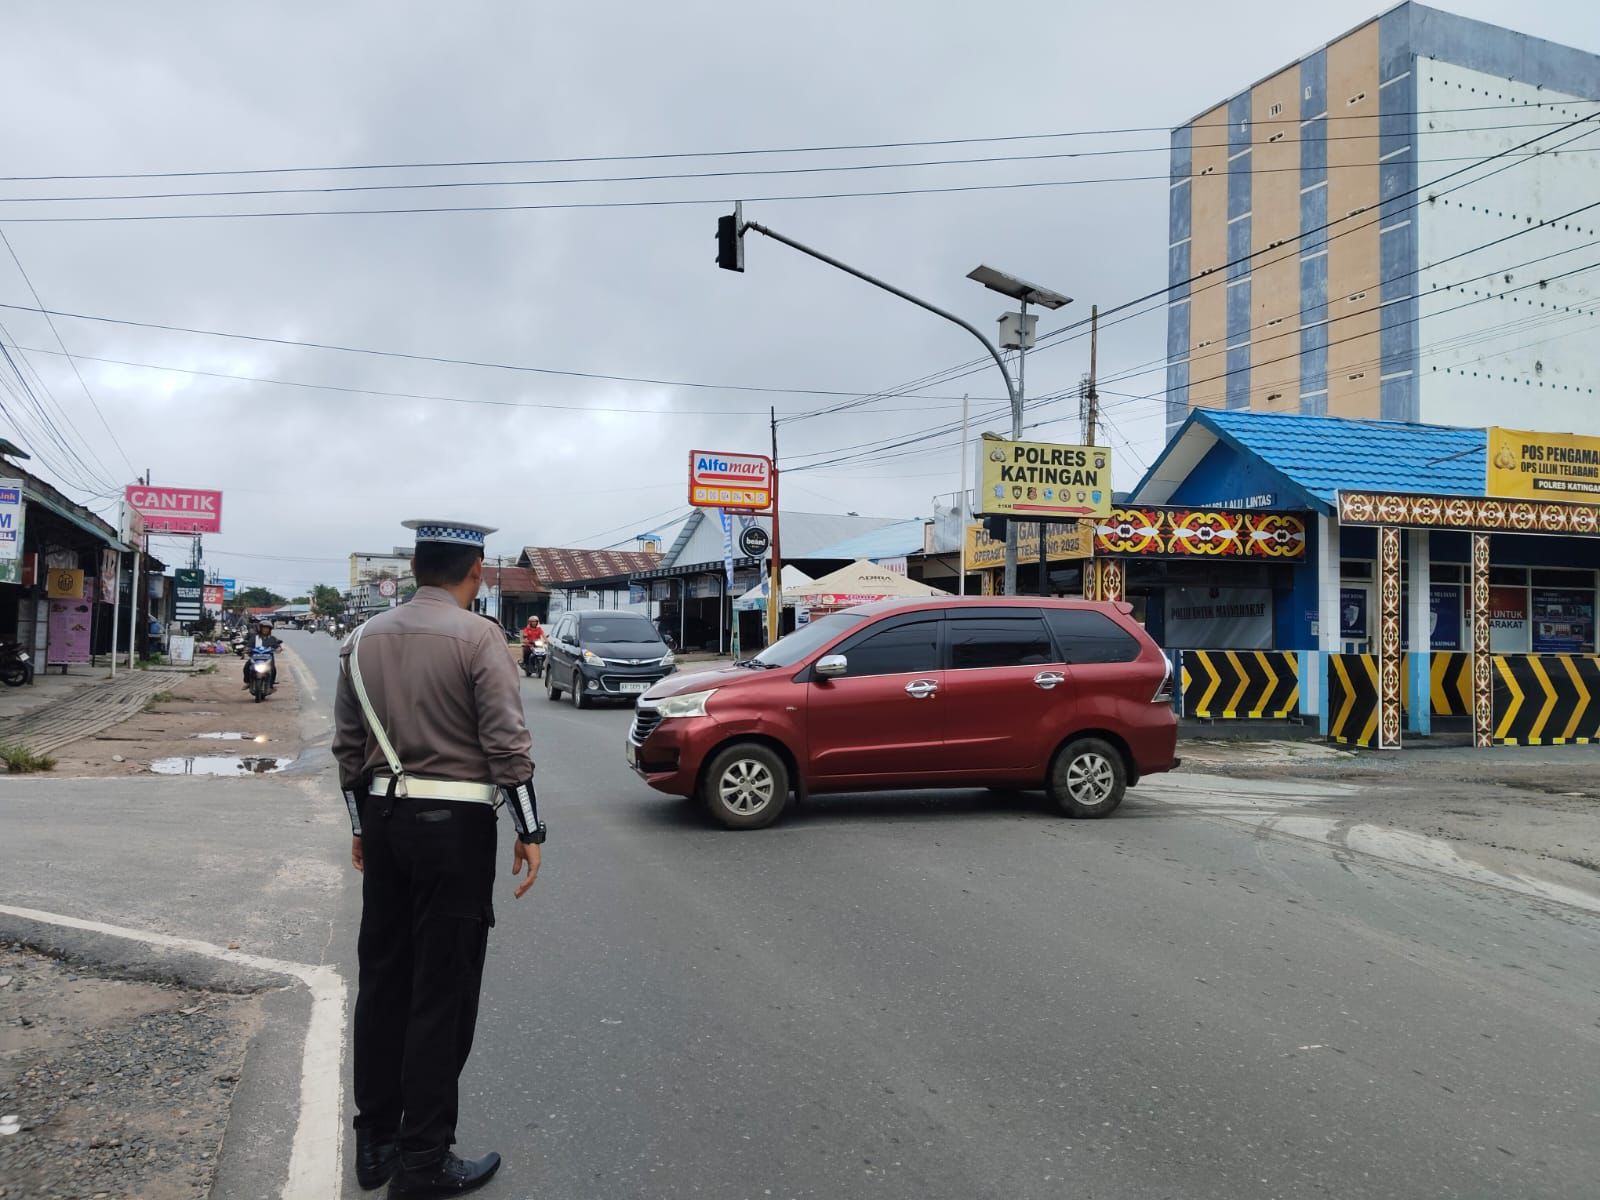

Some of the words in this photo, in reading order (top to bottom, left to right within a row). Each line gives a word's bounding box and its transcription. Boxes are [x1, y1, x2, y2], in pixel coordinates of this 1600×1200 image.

[1014, 446, 1087, 467] POLRES
[1521, 444, 1544, 460] POS
[1546, 446, 1600, 465] PENGAMA
[697, 457, 765, 474] Alfamart
[1520, 461, 1537, 473] OPS
[1538, 463, 1557, 475] LILIN
[1559, 464, 1599, 478] TELABANG
[1001, 465, 1097, 486] KATINGAN
[1538, 480, 1566, 490] POLRES
[131, 491, 215, 511] CANTIK
[1245, 494, 1272, 508] LINTAS
[1061, 538, 1080, 551] 2025
[1493, 610, 1523, 618] UNTUK
